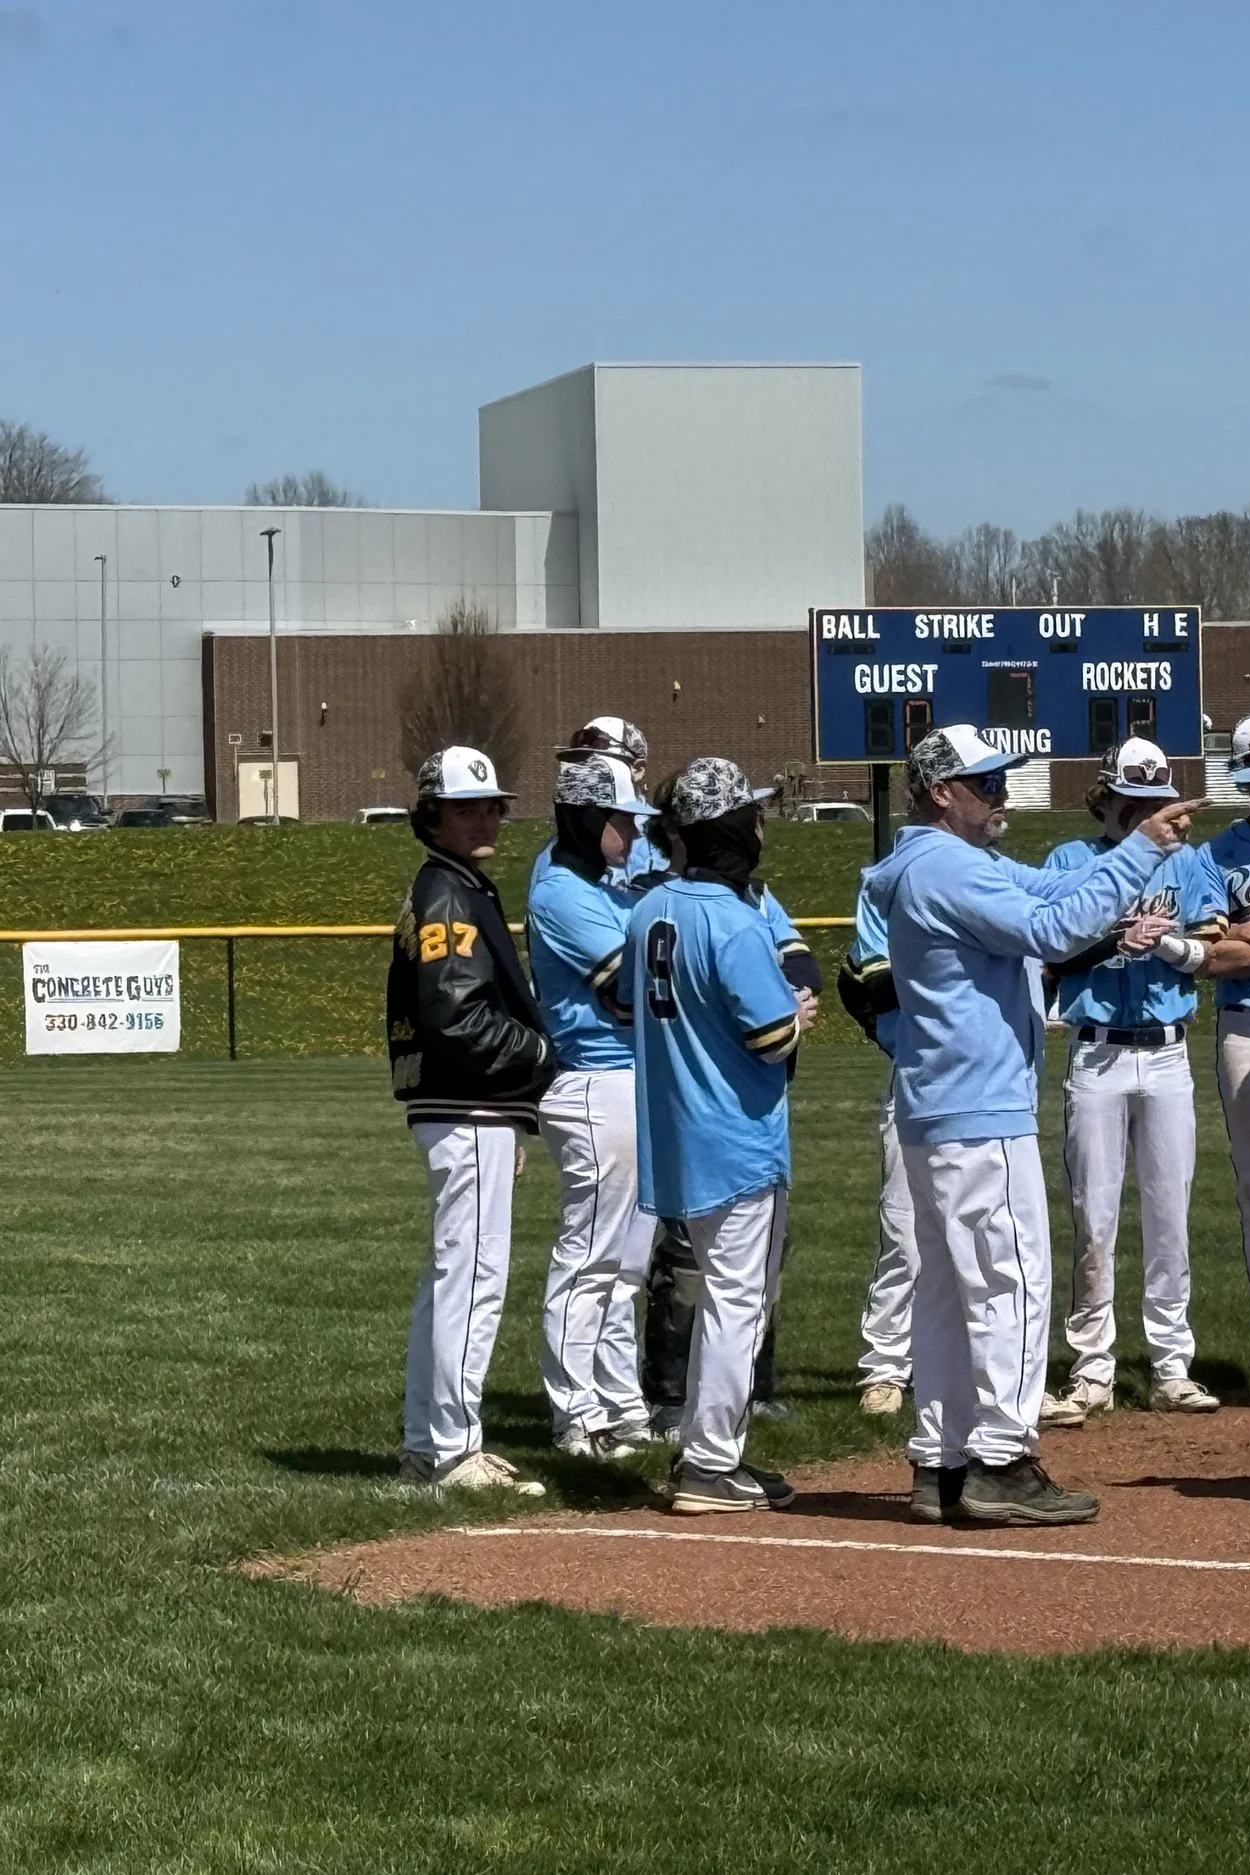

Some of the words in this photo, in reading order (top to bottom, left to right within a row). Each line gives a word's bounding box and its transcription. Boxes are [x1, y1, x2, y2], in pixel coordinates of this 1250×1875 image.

[822, 614, 880, 639] BALL
[915, 613, 995, 639] STRIKE
[1039, 613, 1086, 638] OUT
[1143, 613, 1159, 637] H
[1174, 613, 1188, 637] E
[854, 663, 939, 694] GUEST
[1082, 661, 1172, 691] ROCKETS
[981, 727, 1052, 755] NNING
[419, 921, 479, 964] 27
[646, 918, 678, 1020] 9
[32, 976, 123, 1003] CONCRETE
[126, 974, 174, 1001] GUYS
